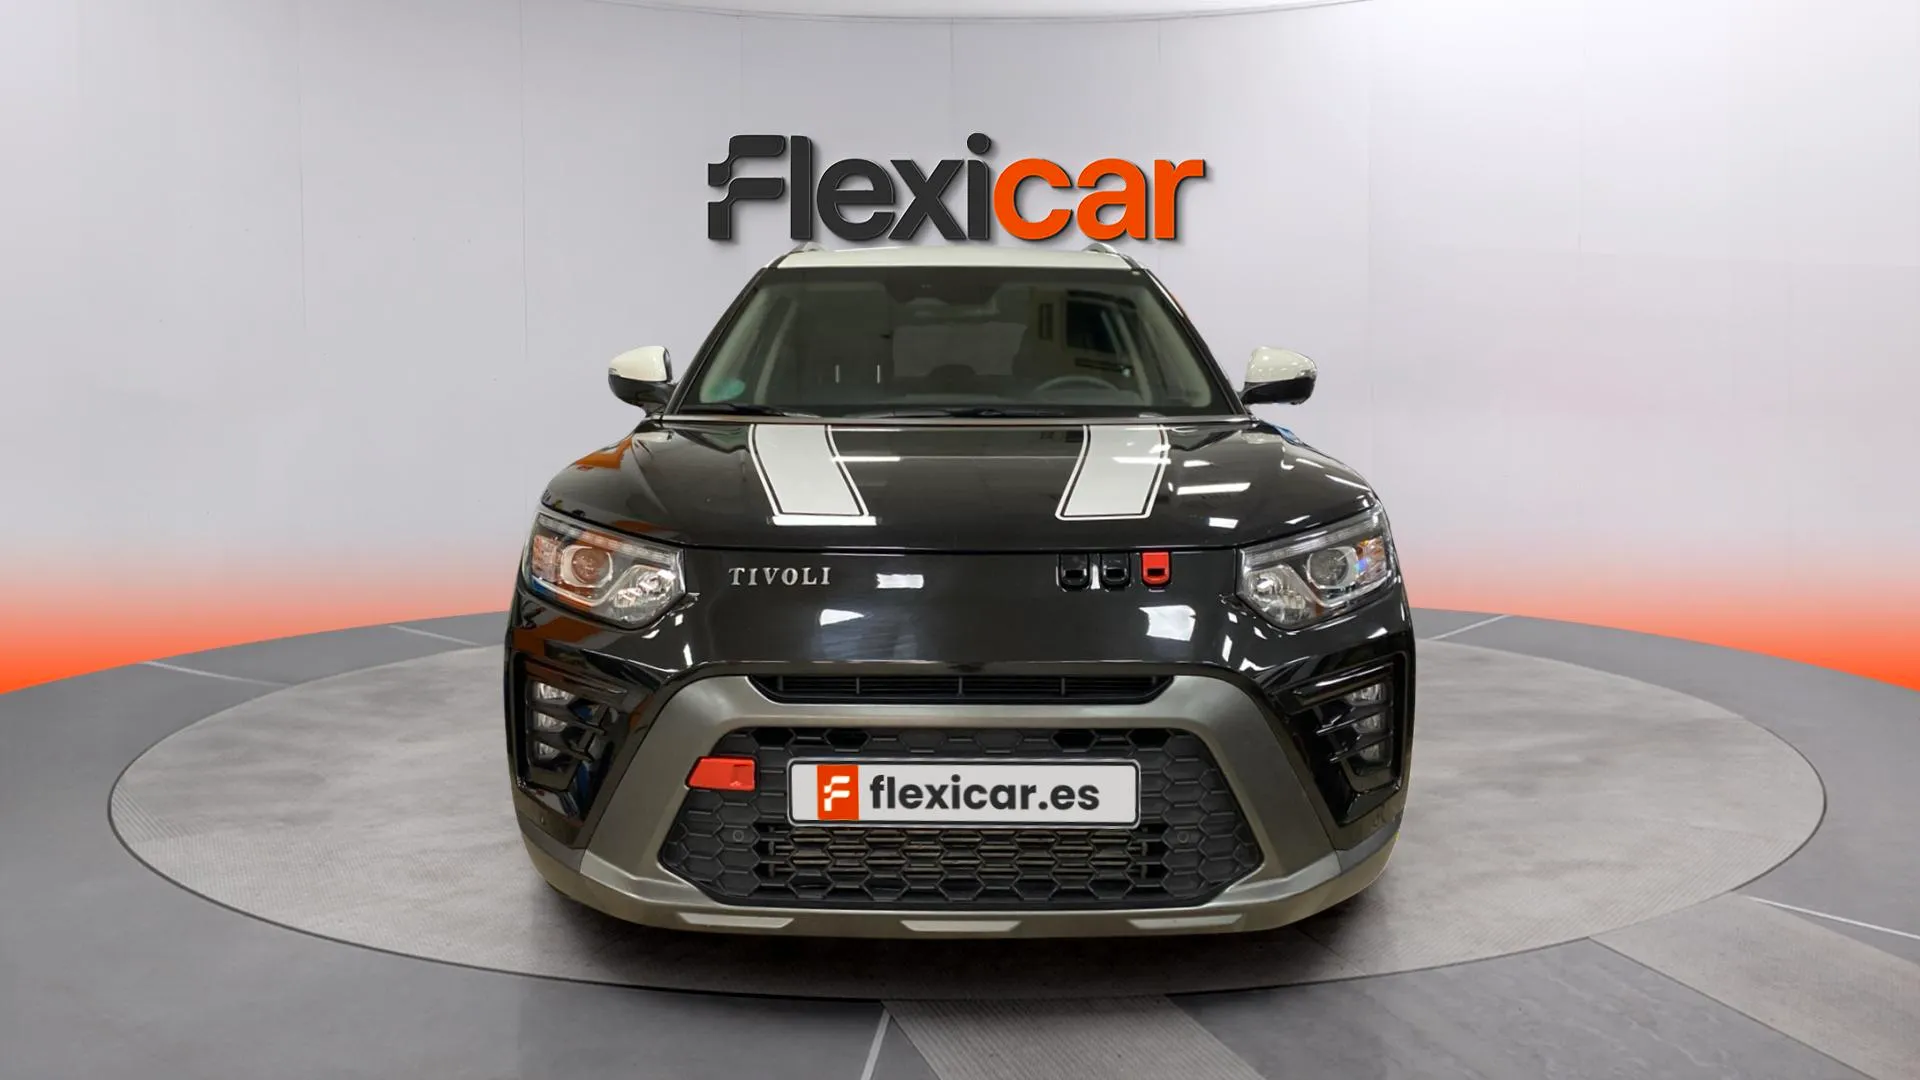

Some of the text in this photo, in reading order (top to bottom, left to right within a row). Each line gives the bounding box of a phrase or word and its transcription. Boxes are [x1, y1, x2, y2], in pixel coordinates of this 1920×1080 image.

[708, 132, 1206, 241] Flexicar
[728, 566, 831, 587] TIVOLI
[870, 774, 1101, 811] flexicar.es
